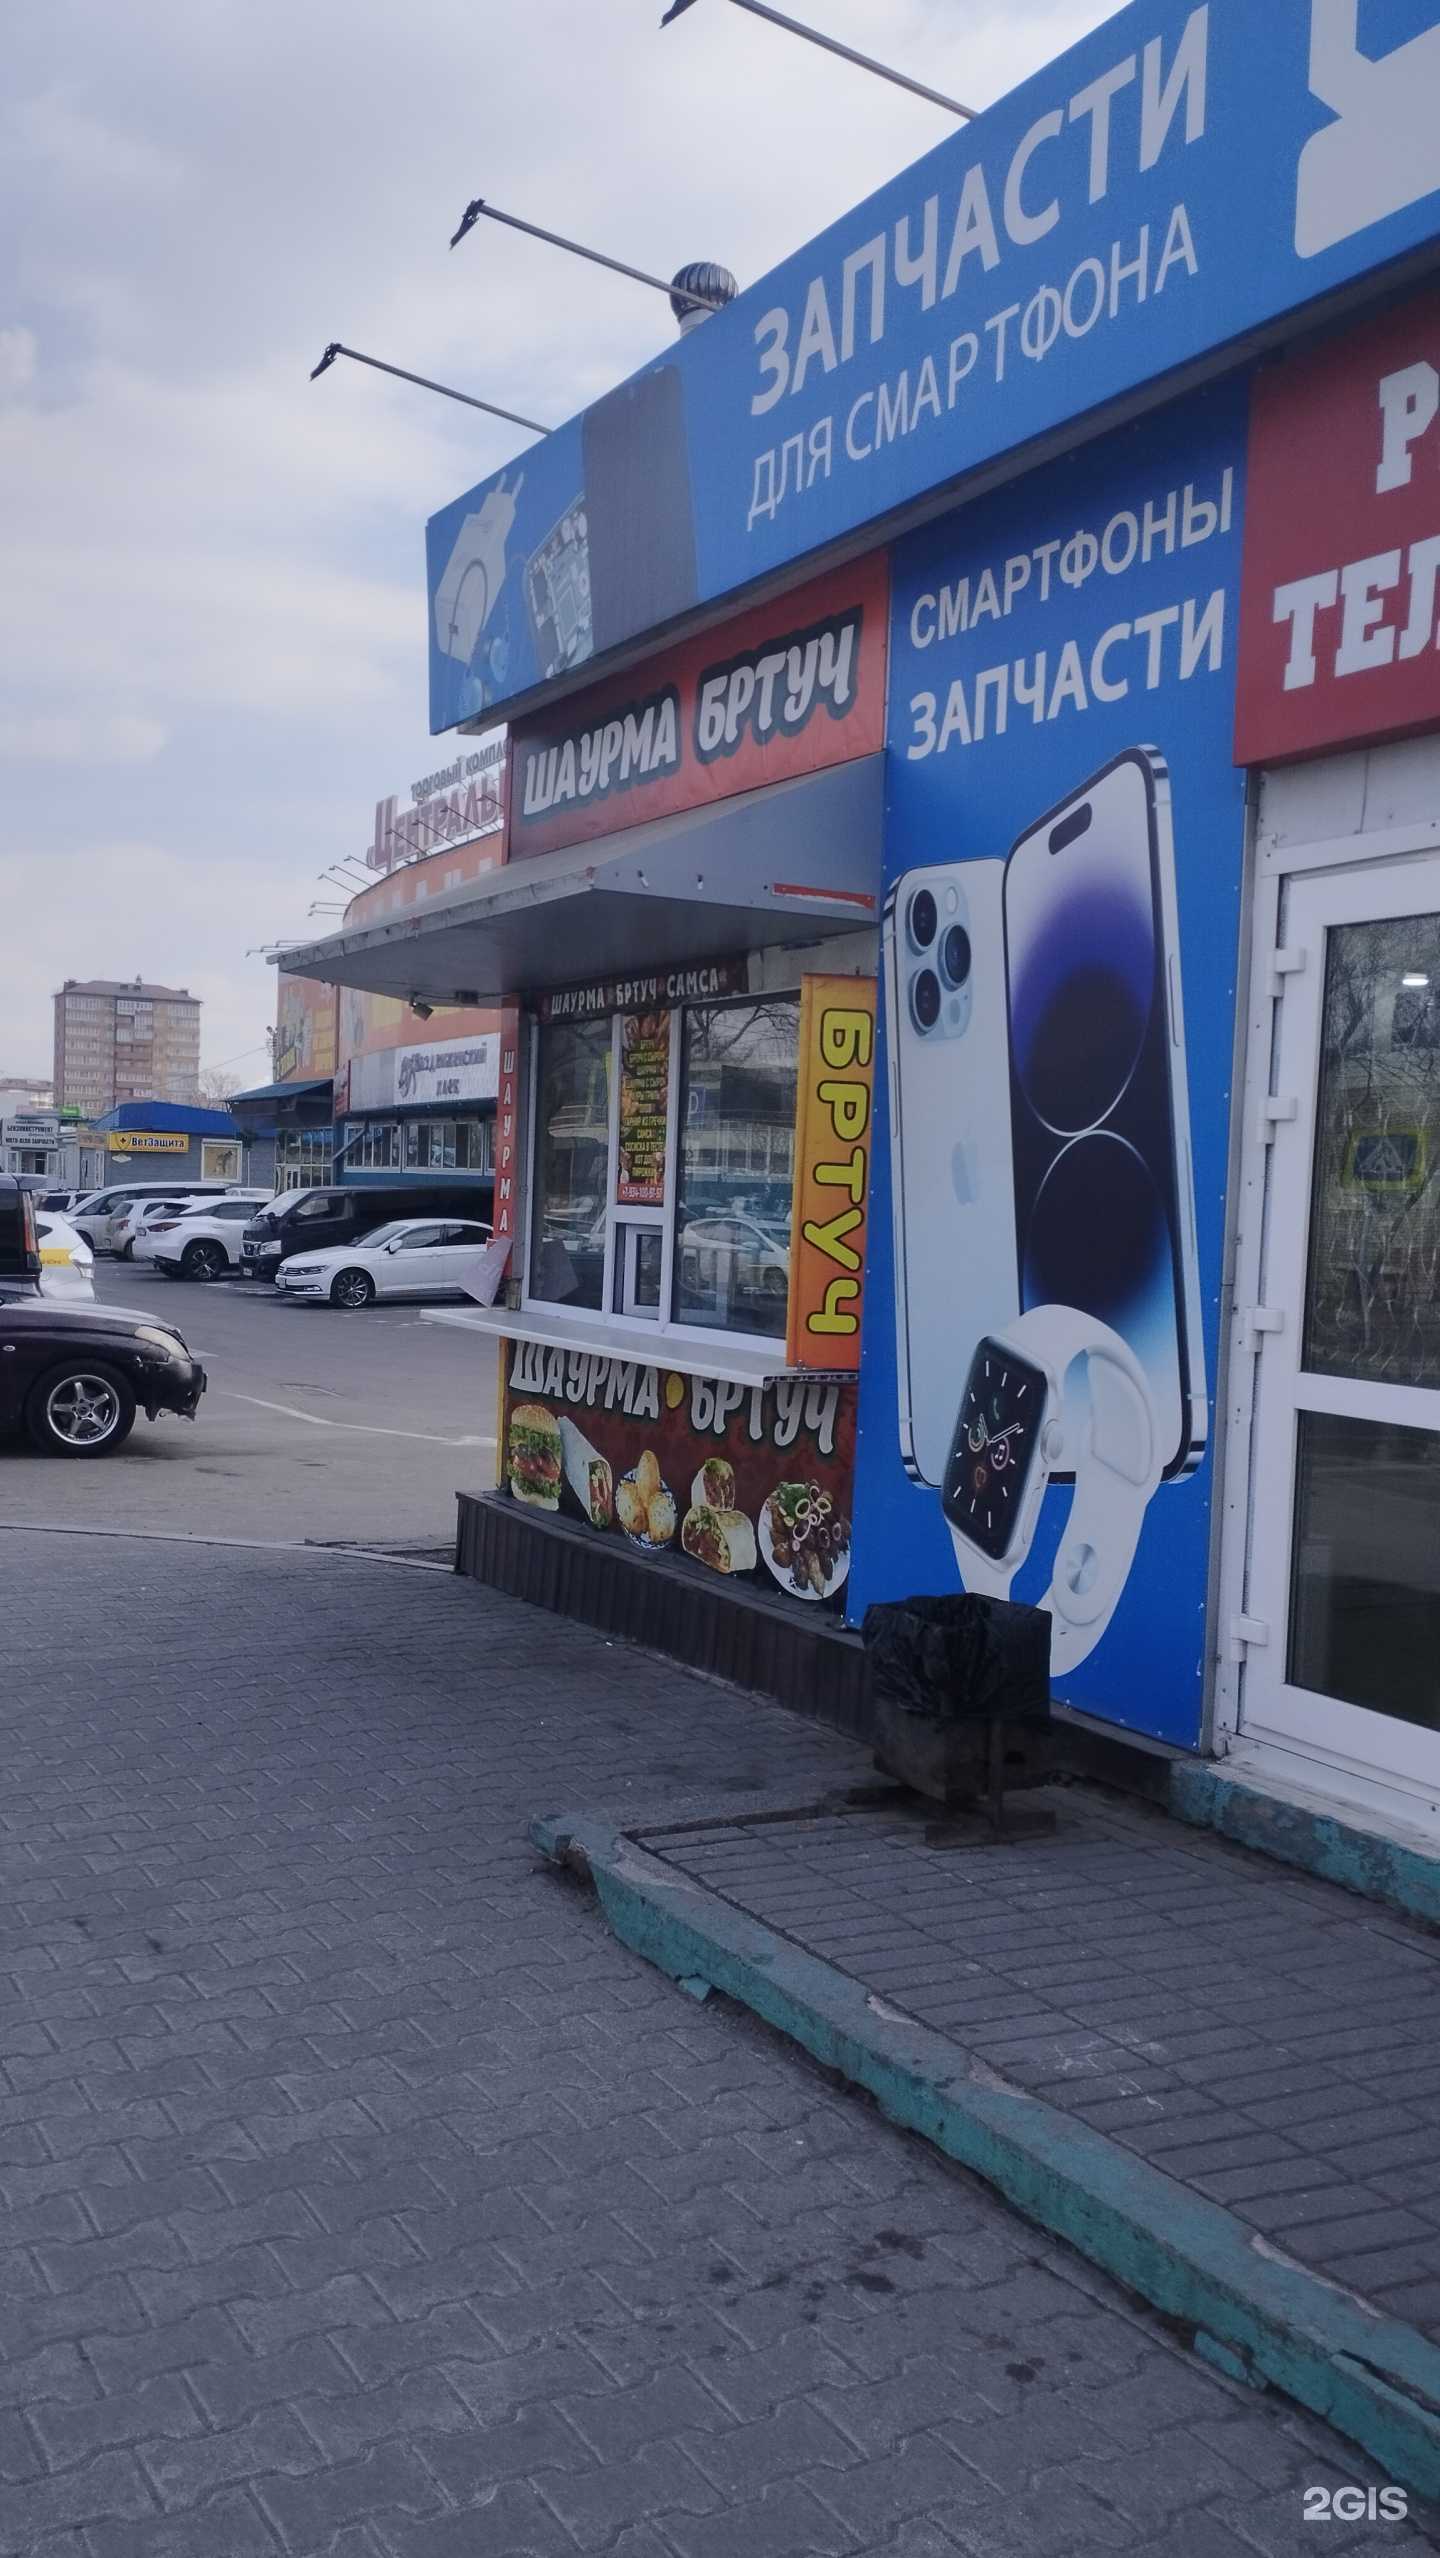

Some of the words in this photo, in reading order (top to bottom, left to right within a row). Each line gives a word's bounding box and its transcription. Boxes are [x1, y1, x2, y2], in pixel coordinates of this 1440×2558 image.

[751, 3, 1208, 416] ЗАПЧАСТИ
[747, 415, 832, 532] ДЛЯ
[846, 203, 1198, 461] СМАРТФОНА
[1376, 361, 1440, 494] Р
[910, 466, 1233, 649] СМАРТФОНЫ
[523, 697, 677, 816] ШАУРМА
[699, 624, 856, 752] БРТУЧ
[907, 588, 1225, 760] ЗАПЧАСТИ
[367, 766, 506, 873] ЦЕНТРАЛЬ
[411, 755, 464, 801] ТОРГОВЫЙ
[551, 986, 605, 1015] ШАУРМА
[616, 977, 657, 1006] БРТУЧ
[666, 967, 719, 998] САМСА
[131, 1137, 185, 1148] ВетЗащита
[499, 1051, 514, 1231] ШАУРМА
[802, 1007, 874, 1335] БРТУЧ
[509, 1341, 659, 1419] ШАУРМА
[690, 1374, 838, 1454] БРТУЧ
